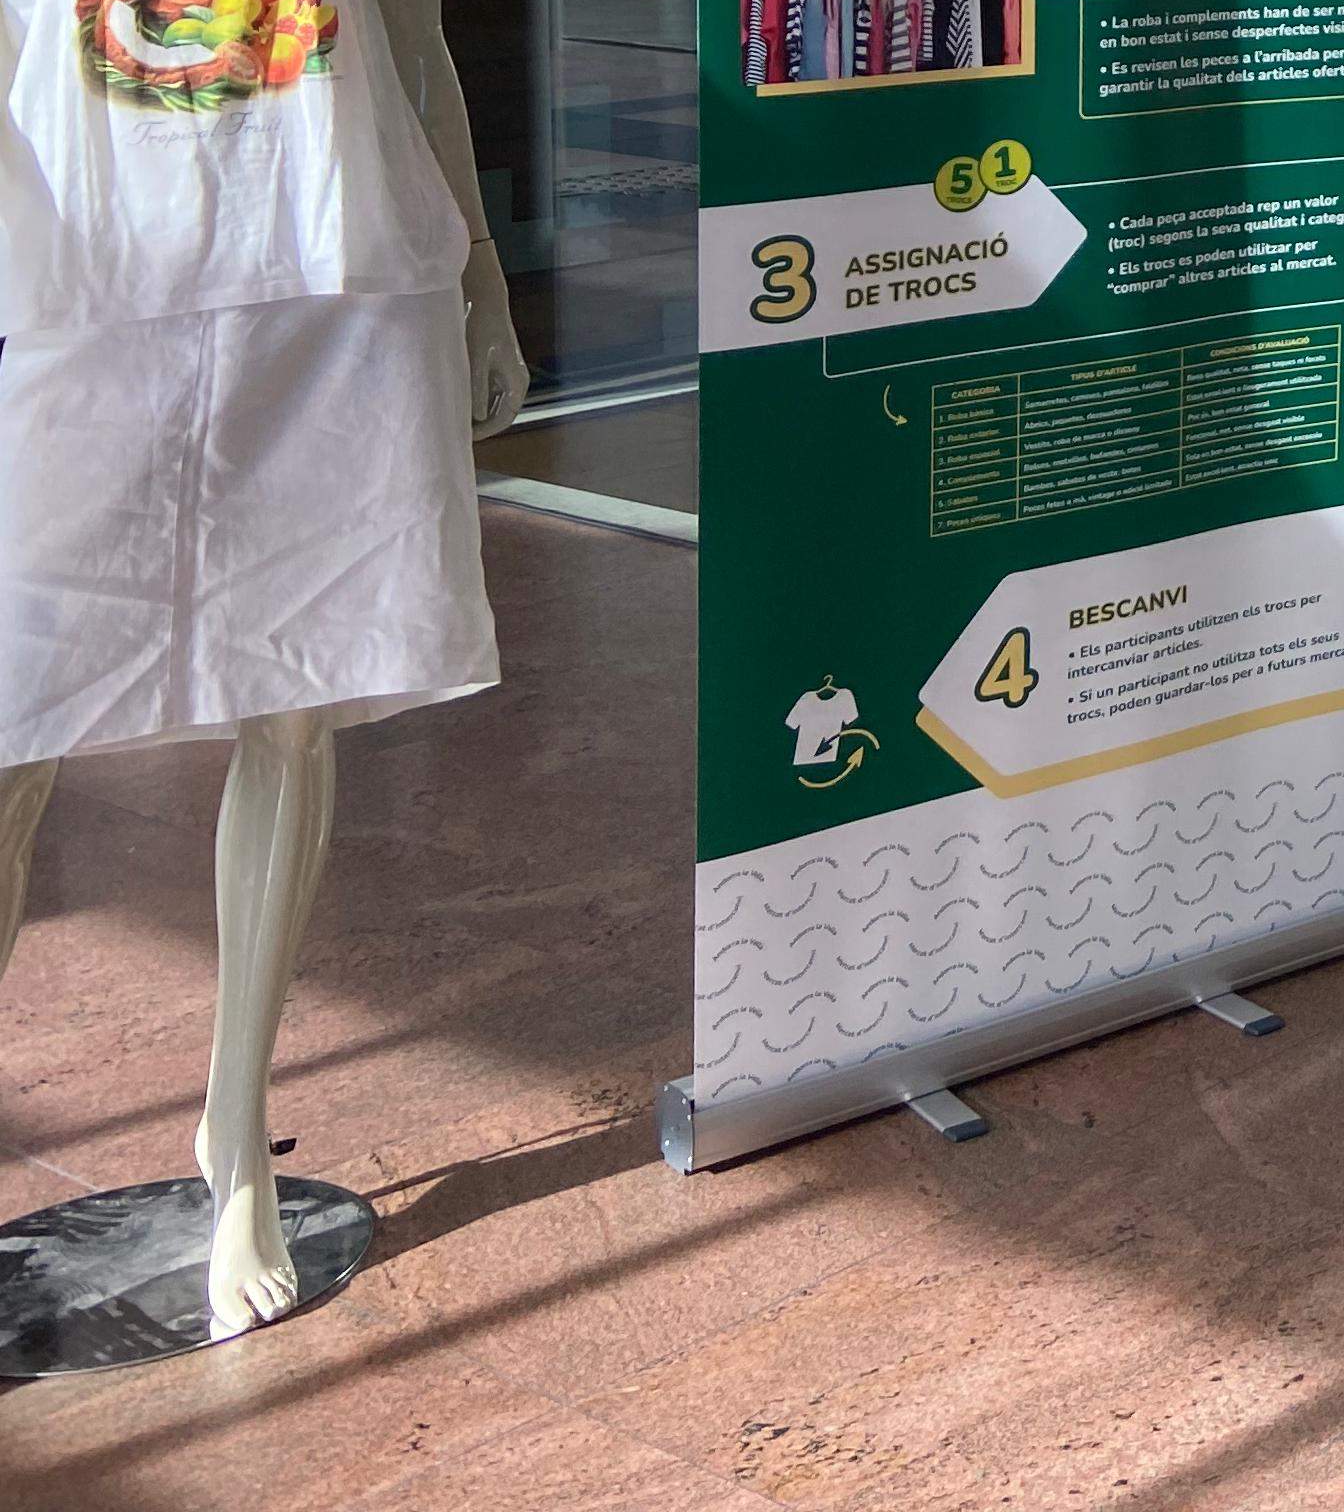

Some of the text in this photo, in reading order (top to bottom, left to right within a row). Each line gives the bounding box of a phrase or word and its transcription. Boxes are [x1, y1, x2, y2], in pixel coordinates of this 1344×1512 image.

[1100, 38, 1116, 48] en
[1121, 34, 1146, 47] bon
[1150, 31, 1181, 44] estat
[1185, 29, 1188, 41] i
[1192, 28, 1229, 41] sense
[1232, 23, 1319, 39] desperfectes
[1112, 16, 1128, 28] La
[1132, 15, 1161, 27] roba
[1165, 13, 1169, 25] i
[1172, 9, 1260, 25] complements
[1263, 6, 1289, 18] han
[1293, 6, 1310, 17] de
[1313, 6, 1335, 17] ser
[1112, 48, 1344, 74] Es revisen les peces a l'arribada per
[1100, 79, 1154, 98] garantir
[1158, 77, 1169, 88] la
[1173, 71, 1223, 89] qualitat
[1226, 70, 1254, 83] dels
[1258, 67, 1309, 81] articles
[128, 112, 282, 149] Tropical Fruit
[951, 163, 972, 194] 5
[994, 146, 1016, 177] 1
[1120, 195, 1339, 230] Cada peça acceptada rep un valor
[1108, 236, 1145, 253] (troc)
[1149, 228, 1193, 246] segons
[1197, 226, 1208, 238] la
[1212, 224, 1240, 235] seva
[1244, 216, 1298, 234] qualitat
[1301, 213, 1305, 225] i
[845, 233, 1008, 278] ASSIGNACIÓ
[1119, 240, 1318, 275] Els trocs es poden utilitzar per
[1178, 269, 1214, 285] altres
[1217, 263, 1266, 278] articles
[1270, 259, 1283, 271] al
[1286, 255, 1337, 270] mercat.
[750, 234, 817, 324] 3
[846, 272, 976, 309] DE TROCS
[1069, 585, 1187, 629] BESCANVI
[1080, 593, 1322, 658] Els participants utilitzen els trocs per
[975, 627, 1039, 708] 4
[1068, 640, 1204, 679] intercanviar articles.
[1080, 632, 1340, 703] Si un participant no utilitza tots els seus
[1067, 709, 1105, 724] trocs,
[1109, 697, 1151, 716] poden
[1155, 675, 1229, 705] guardar-los
[1232, 669, 1252, 683] per
[1257, 666, 1264, 674] a
[1268, 656, 1307, 672] futurs
